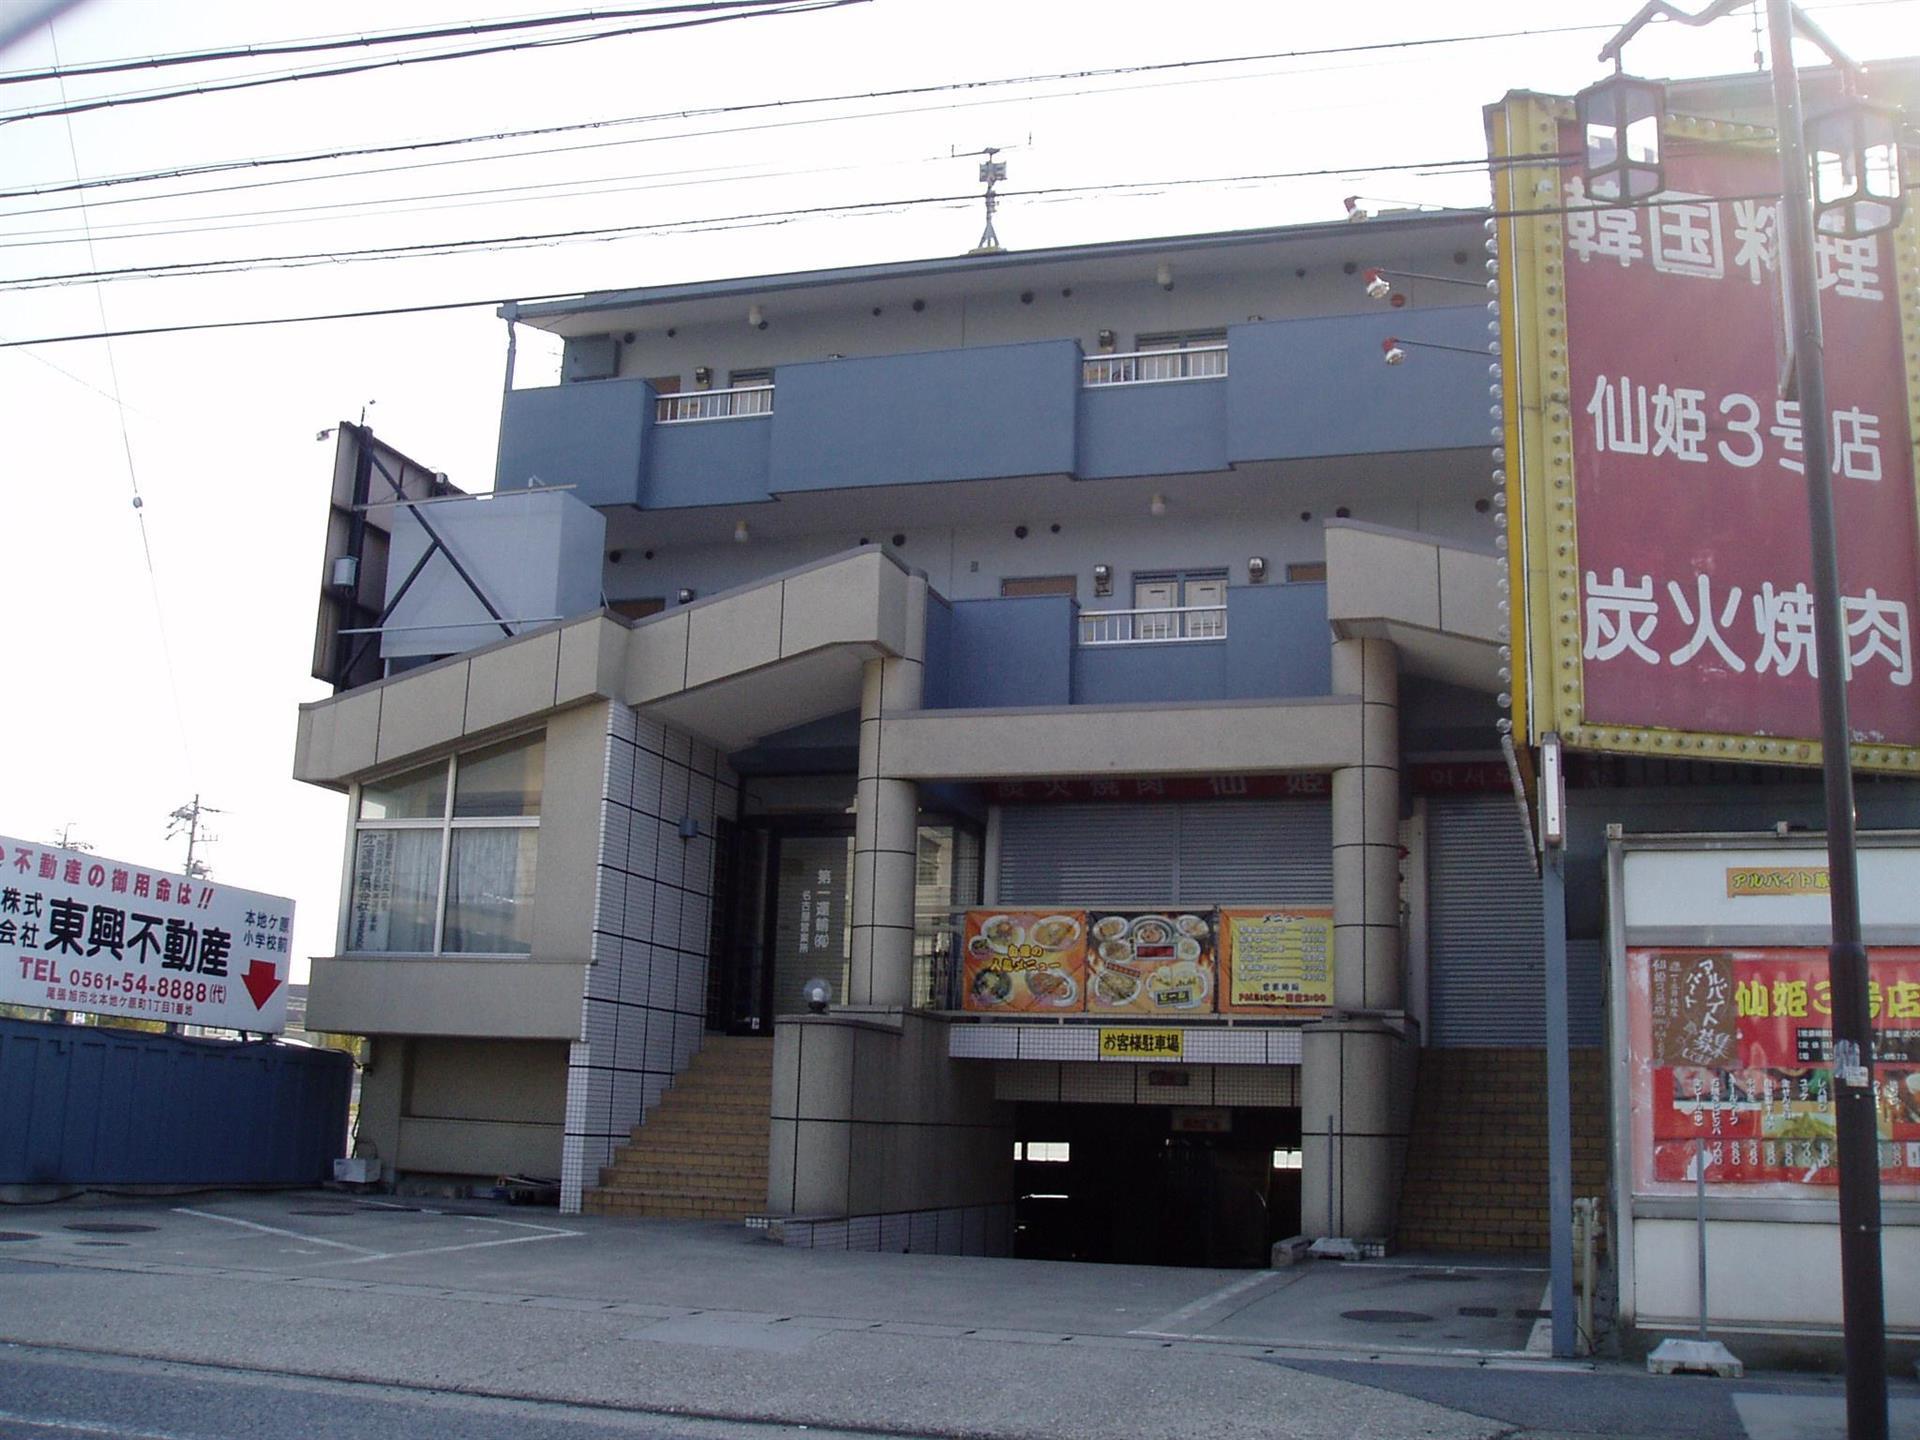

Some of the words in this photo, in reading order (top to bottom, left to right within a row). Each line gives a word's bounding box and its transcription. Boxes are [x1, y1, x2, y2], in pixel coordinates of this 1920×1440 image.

[1582, 566, 1915, 687] 炭火焼肉
[1, 887, 44, 918] 株式
[0, 918, 40, 949] 会社
[44, 897, 232, 978] 東興不動産
[19, 956, 61, 983] TEL
[1103, 1031, 1180, 1054] お客様駐車場
